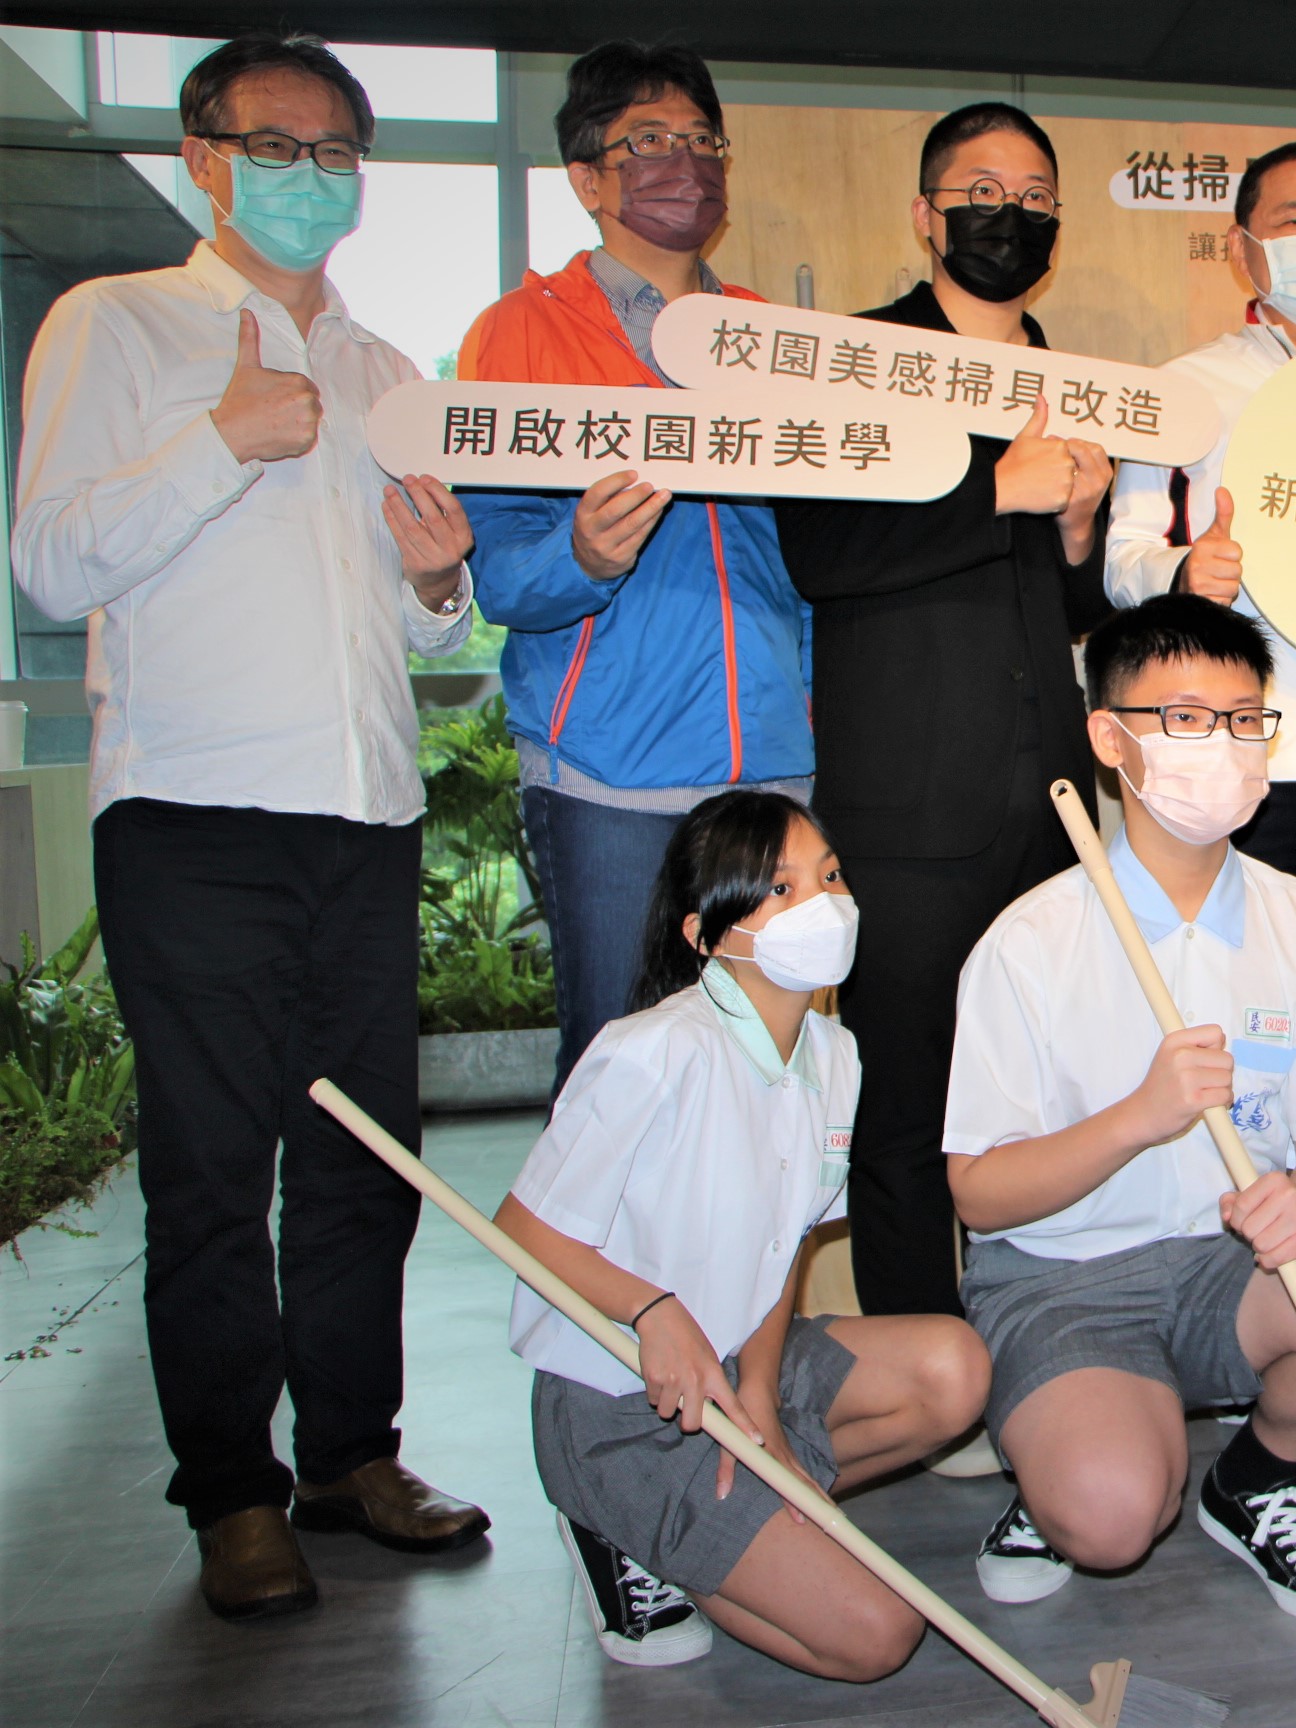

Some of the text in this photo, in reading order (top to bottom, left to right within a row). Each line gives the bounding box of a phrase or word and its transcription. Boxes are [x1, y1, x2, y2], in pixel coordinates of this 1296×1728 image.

[709, 318, 1162, 437] 校園美感掃具改造
[442, 405, 891, 471] 開啟校園新美學
